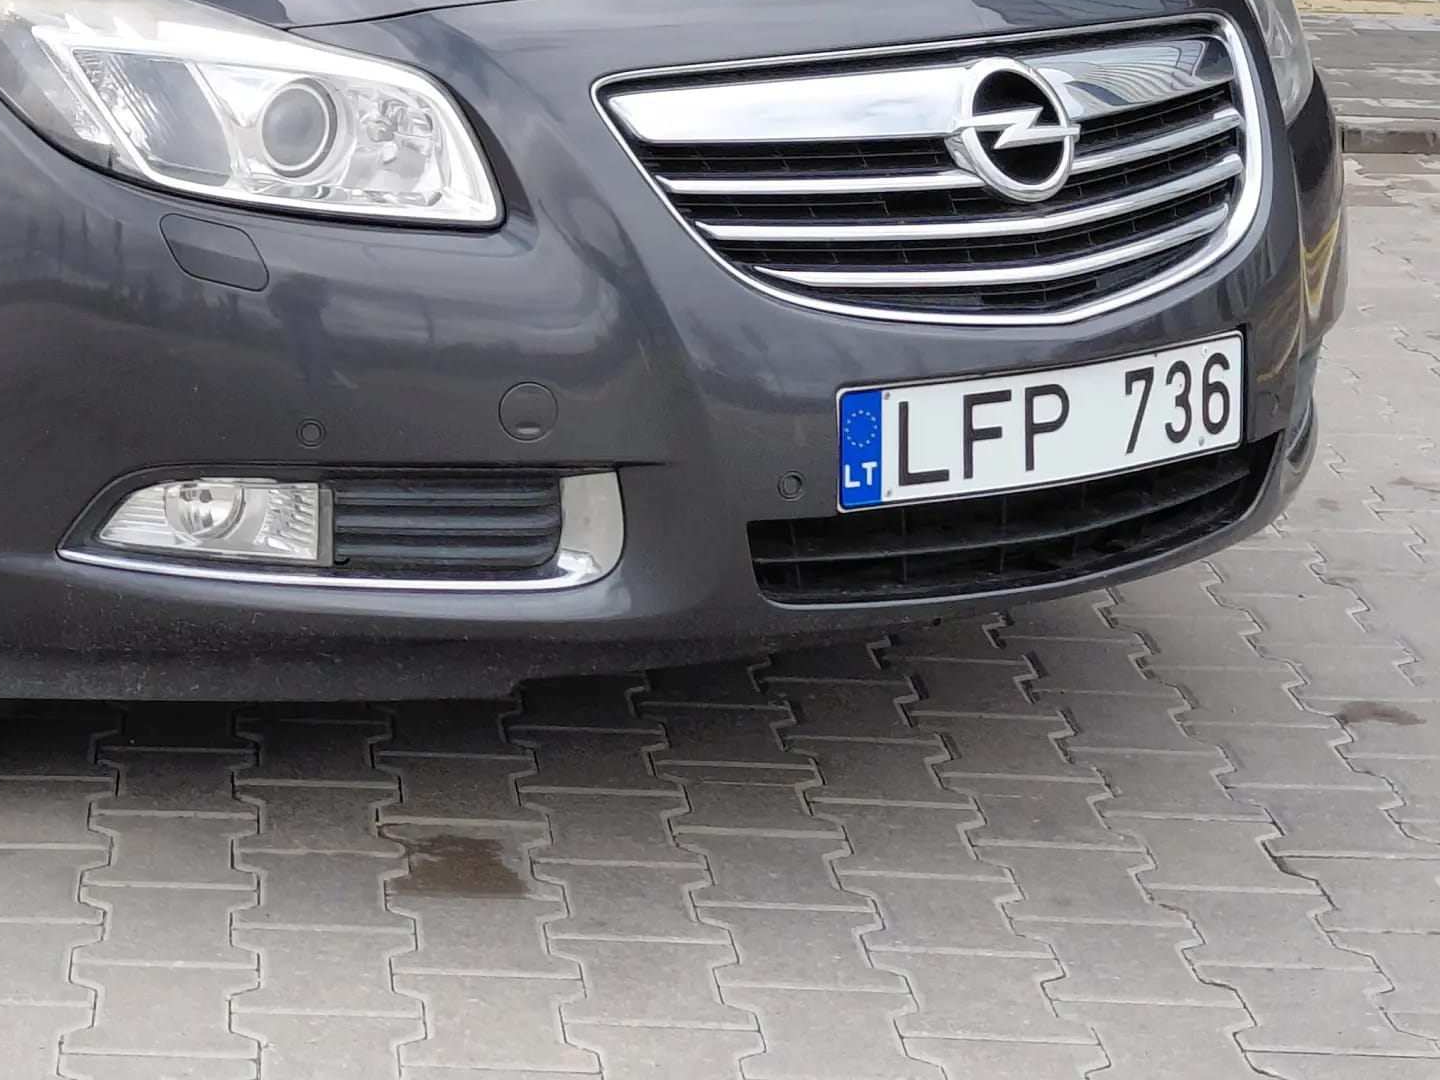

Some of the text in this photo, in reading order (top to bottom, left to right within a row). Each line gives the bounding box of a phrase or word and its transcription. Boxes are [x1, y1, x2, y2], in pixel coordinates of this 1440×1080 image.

[897, 352, 1231, 487] LFP 736
[844, 461, 878, 489] LT
